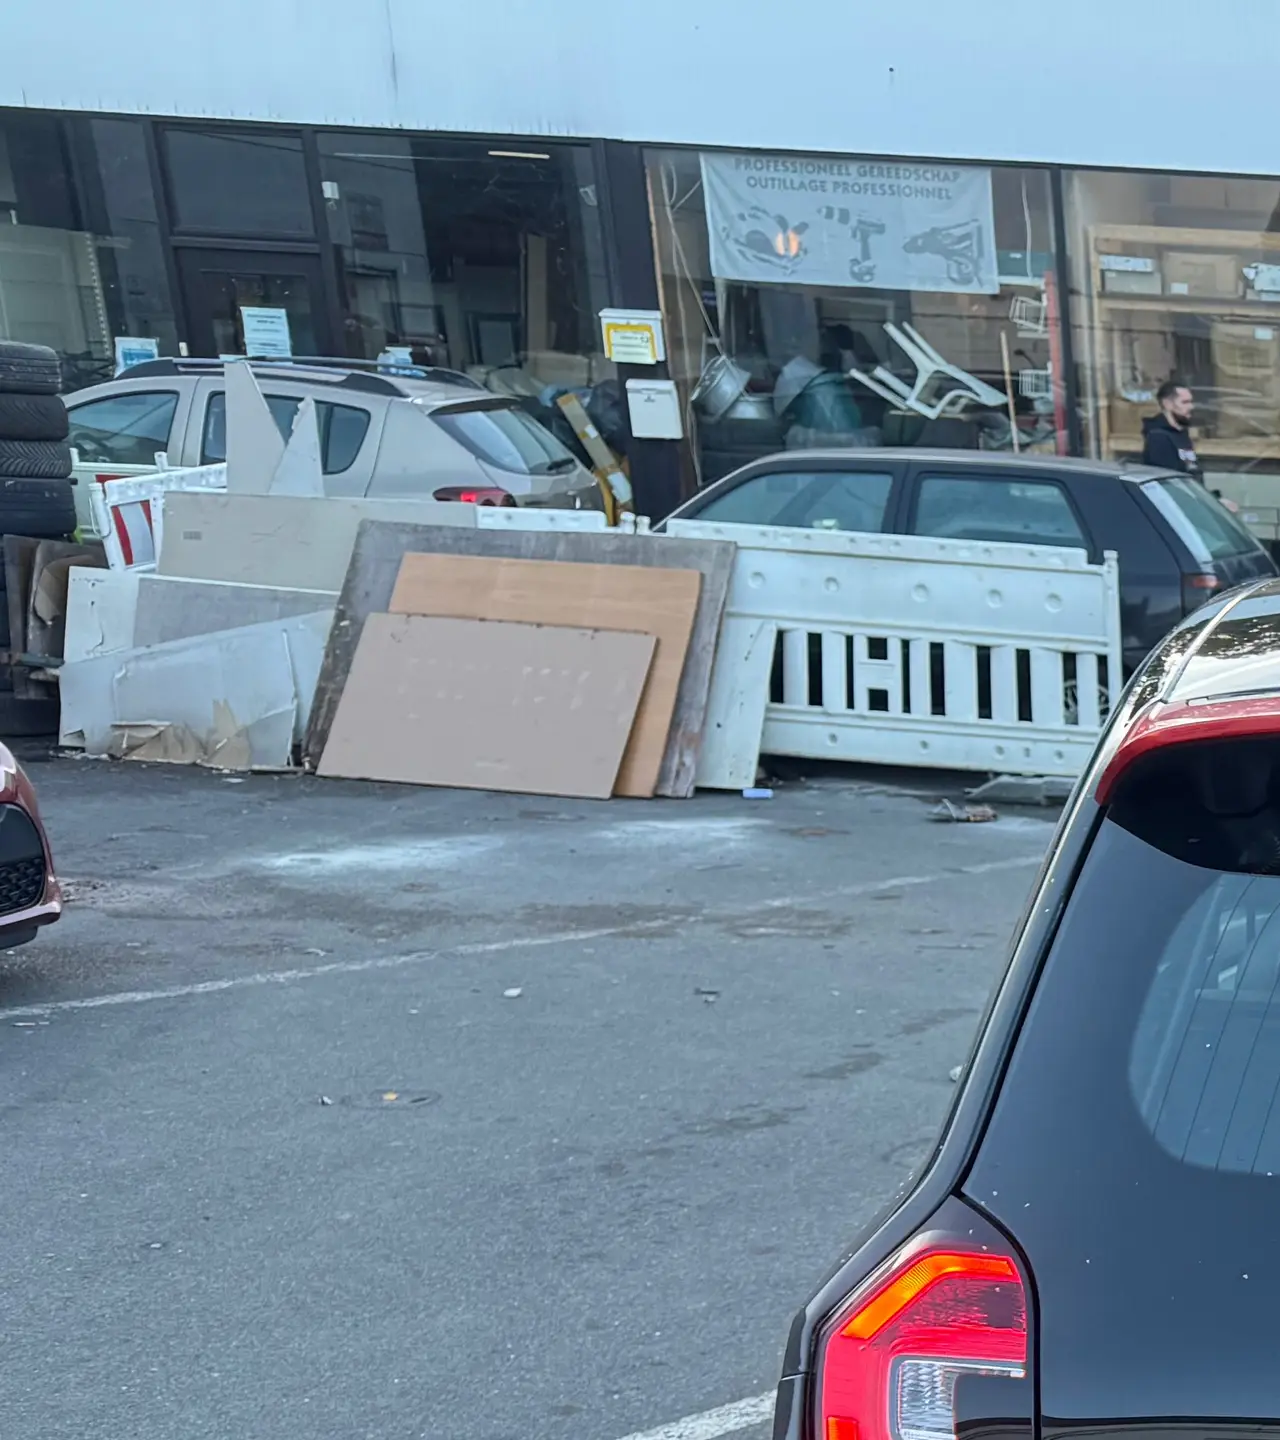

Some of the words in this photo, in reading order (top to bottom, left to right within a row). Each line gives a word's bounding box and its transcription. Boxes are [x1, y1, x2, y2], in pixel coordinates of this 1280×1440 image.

[734, 157, 851, 177] PROFESSIONEEL
[856, 164, 961, 184] GEREEDSCHAP
[746, 175, 827, 194] OUTILLAGE
[832, 180, 953, 200] PROFESSIONNEL
